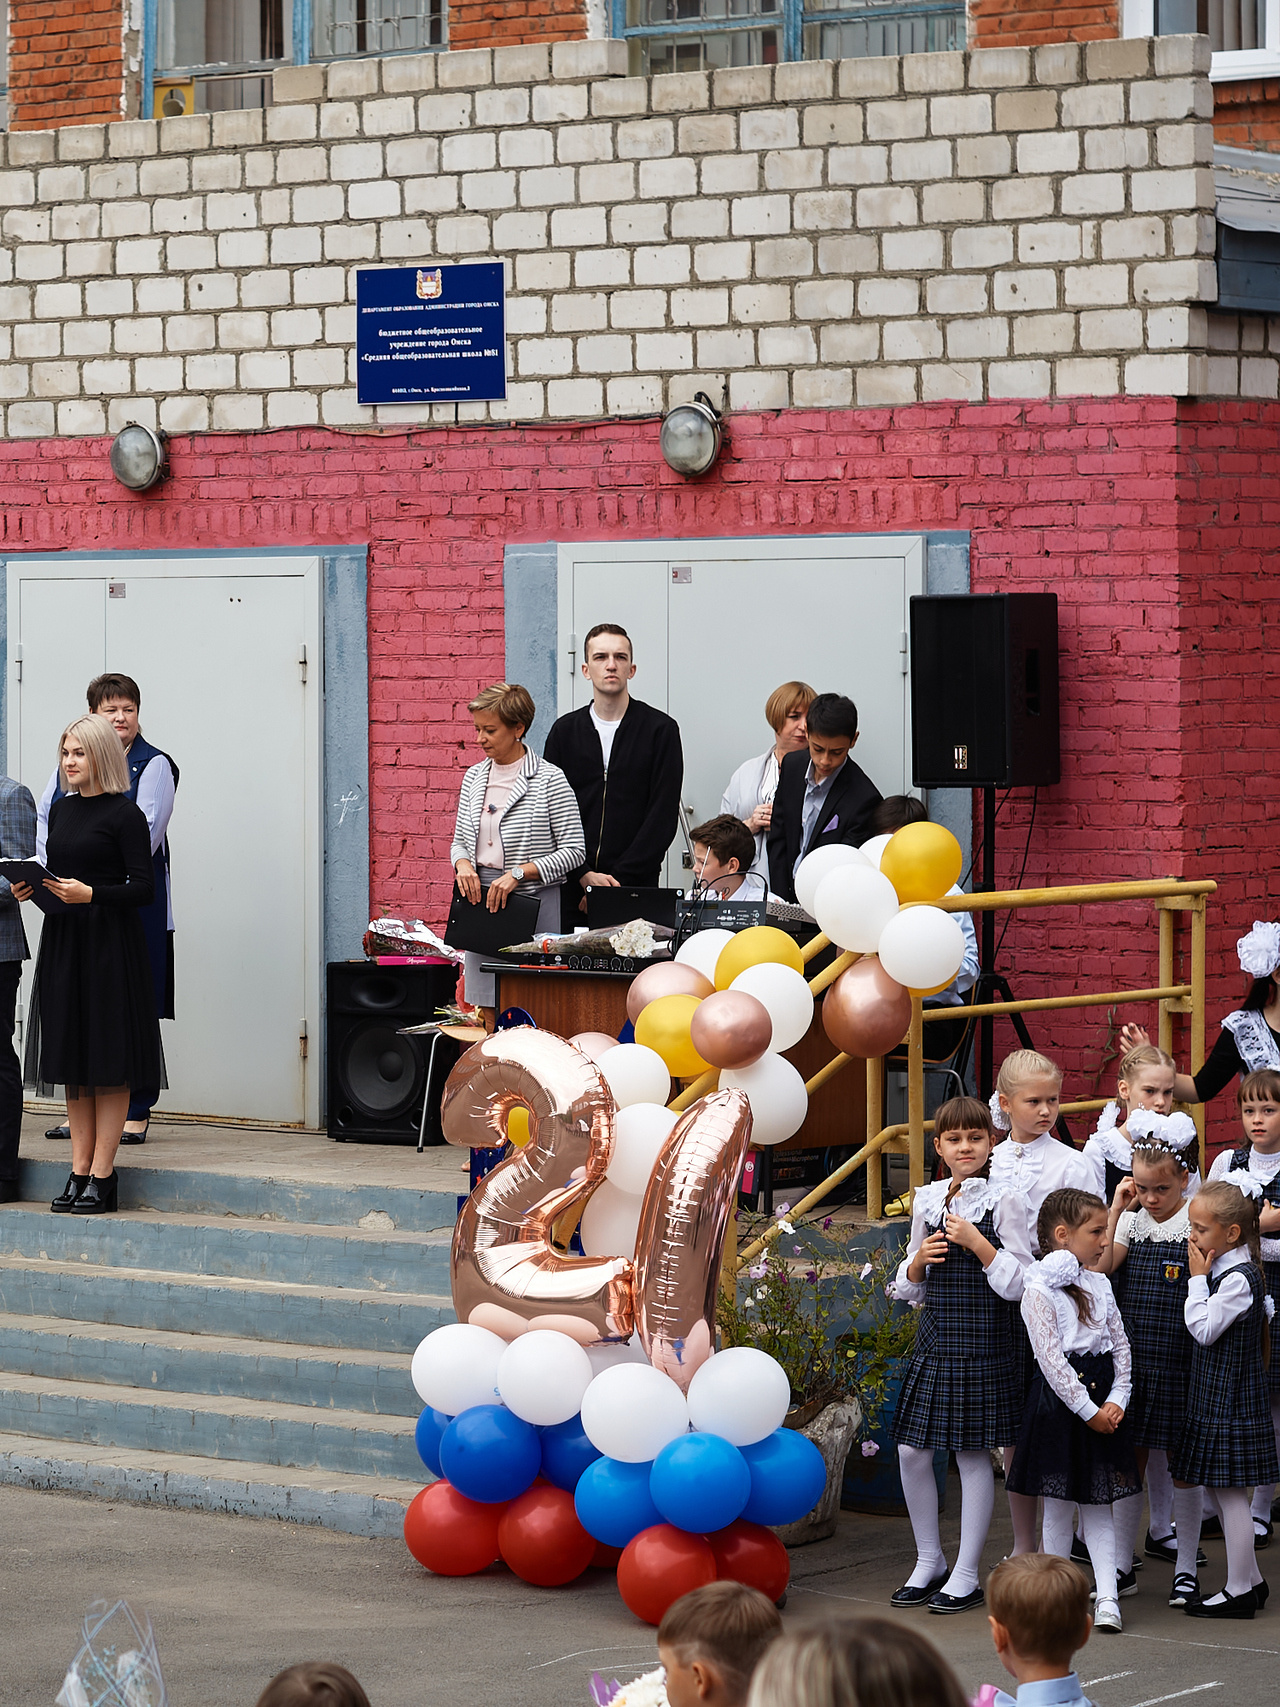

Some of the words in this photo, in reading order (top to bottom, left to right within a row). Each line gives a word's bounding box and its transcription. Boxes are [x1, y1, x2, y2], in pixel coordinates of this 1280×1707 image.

[378, 329, 413, 337] бюджетное
[414, 326, 483, 336] общеобразовательное
[389, 341, 426, 350] учреждение
[428, 340, 449, 348] города
[392, 352, 460, 361] общеобразовательная
